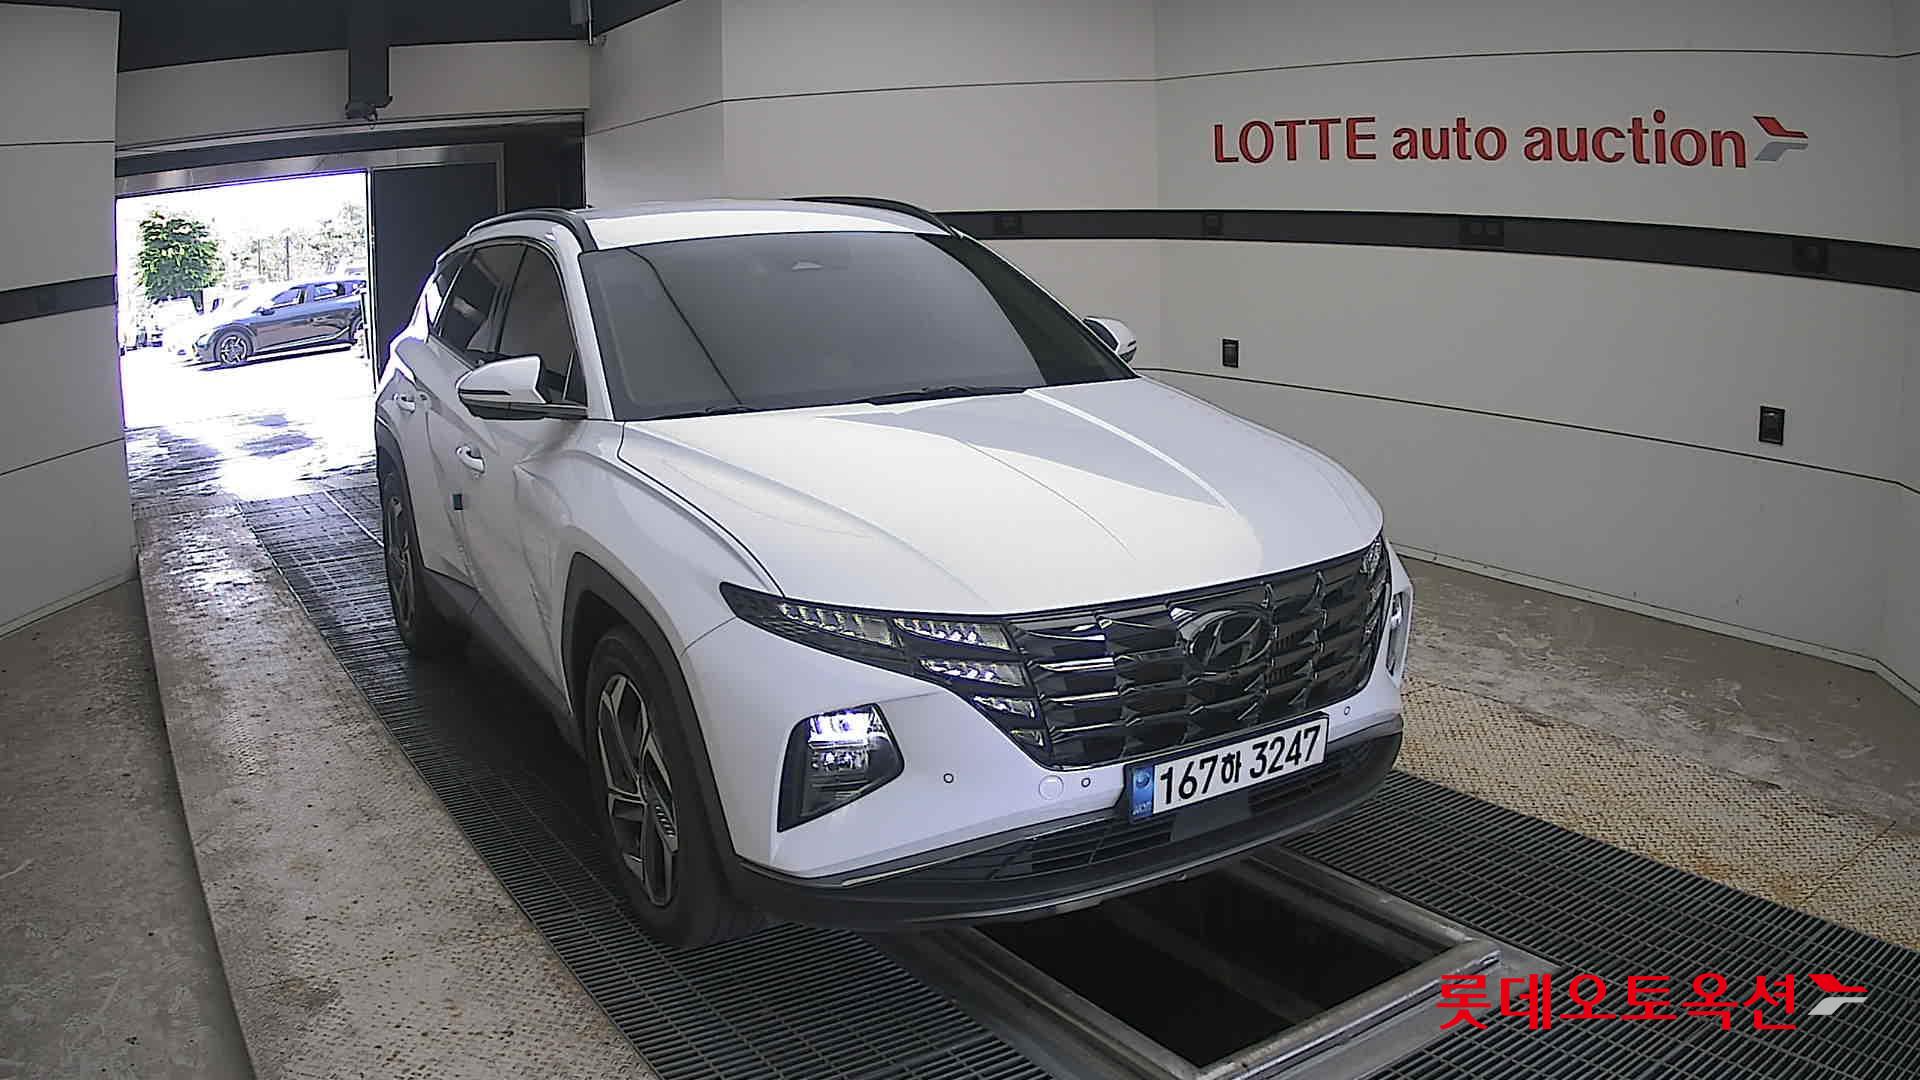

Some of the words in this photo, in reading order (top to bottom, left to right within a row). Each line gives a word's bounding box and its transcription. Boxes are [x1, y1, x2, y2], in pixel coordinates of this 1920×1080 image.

[1213, 116, 1377, 164] LOTTE
[1392, 117, 1508, 162] auto
[1523, 109, 1747, 169] auction
[1160, 751, 1242, 805] 167하
[1250, 726, 1321, 779] 3247
